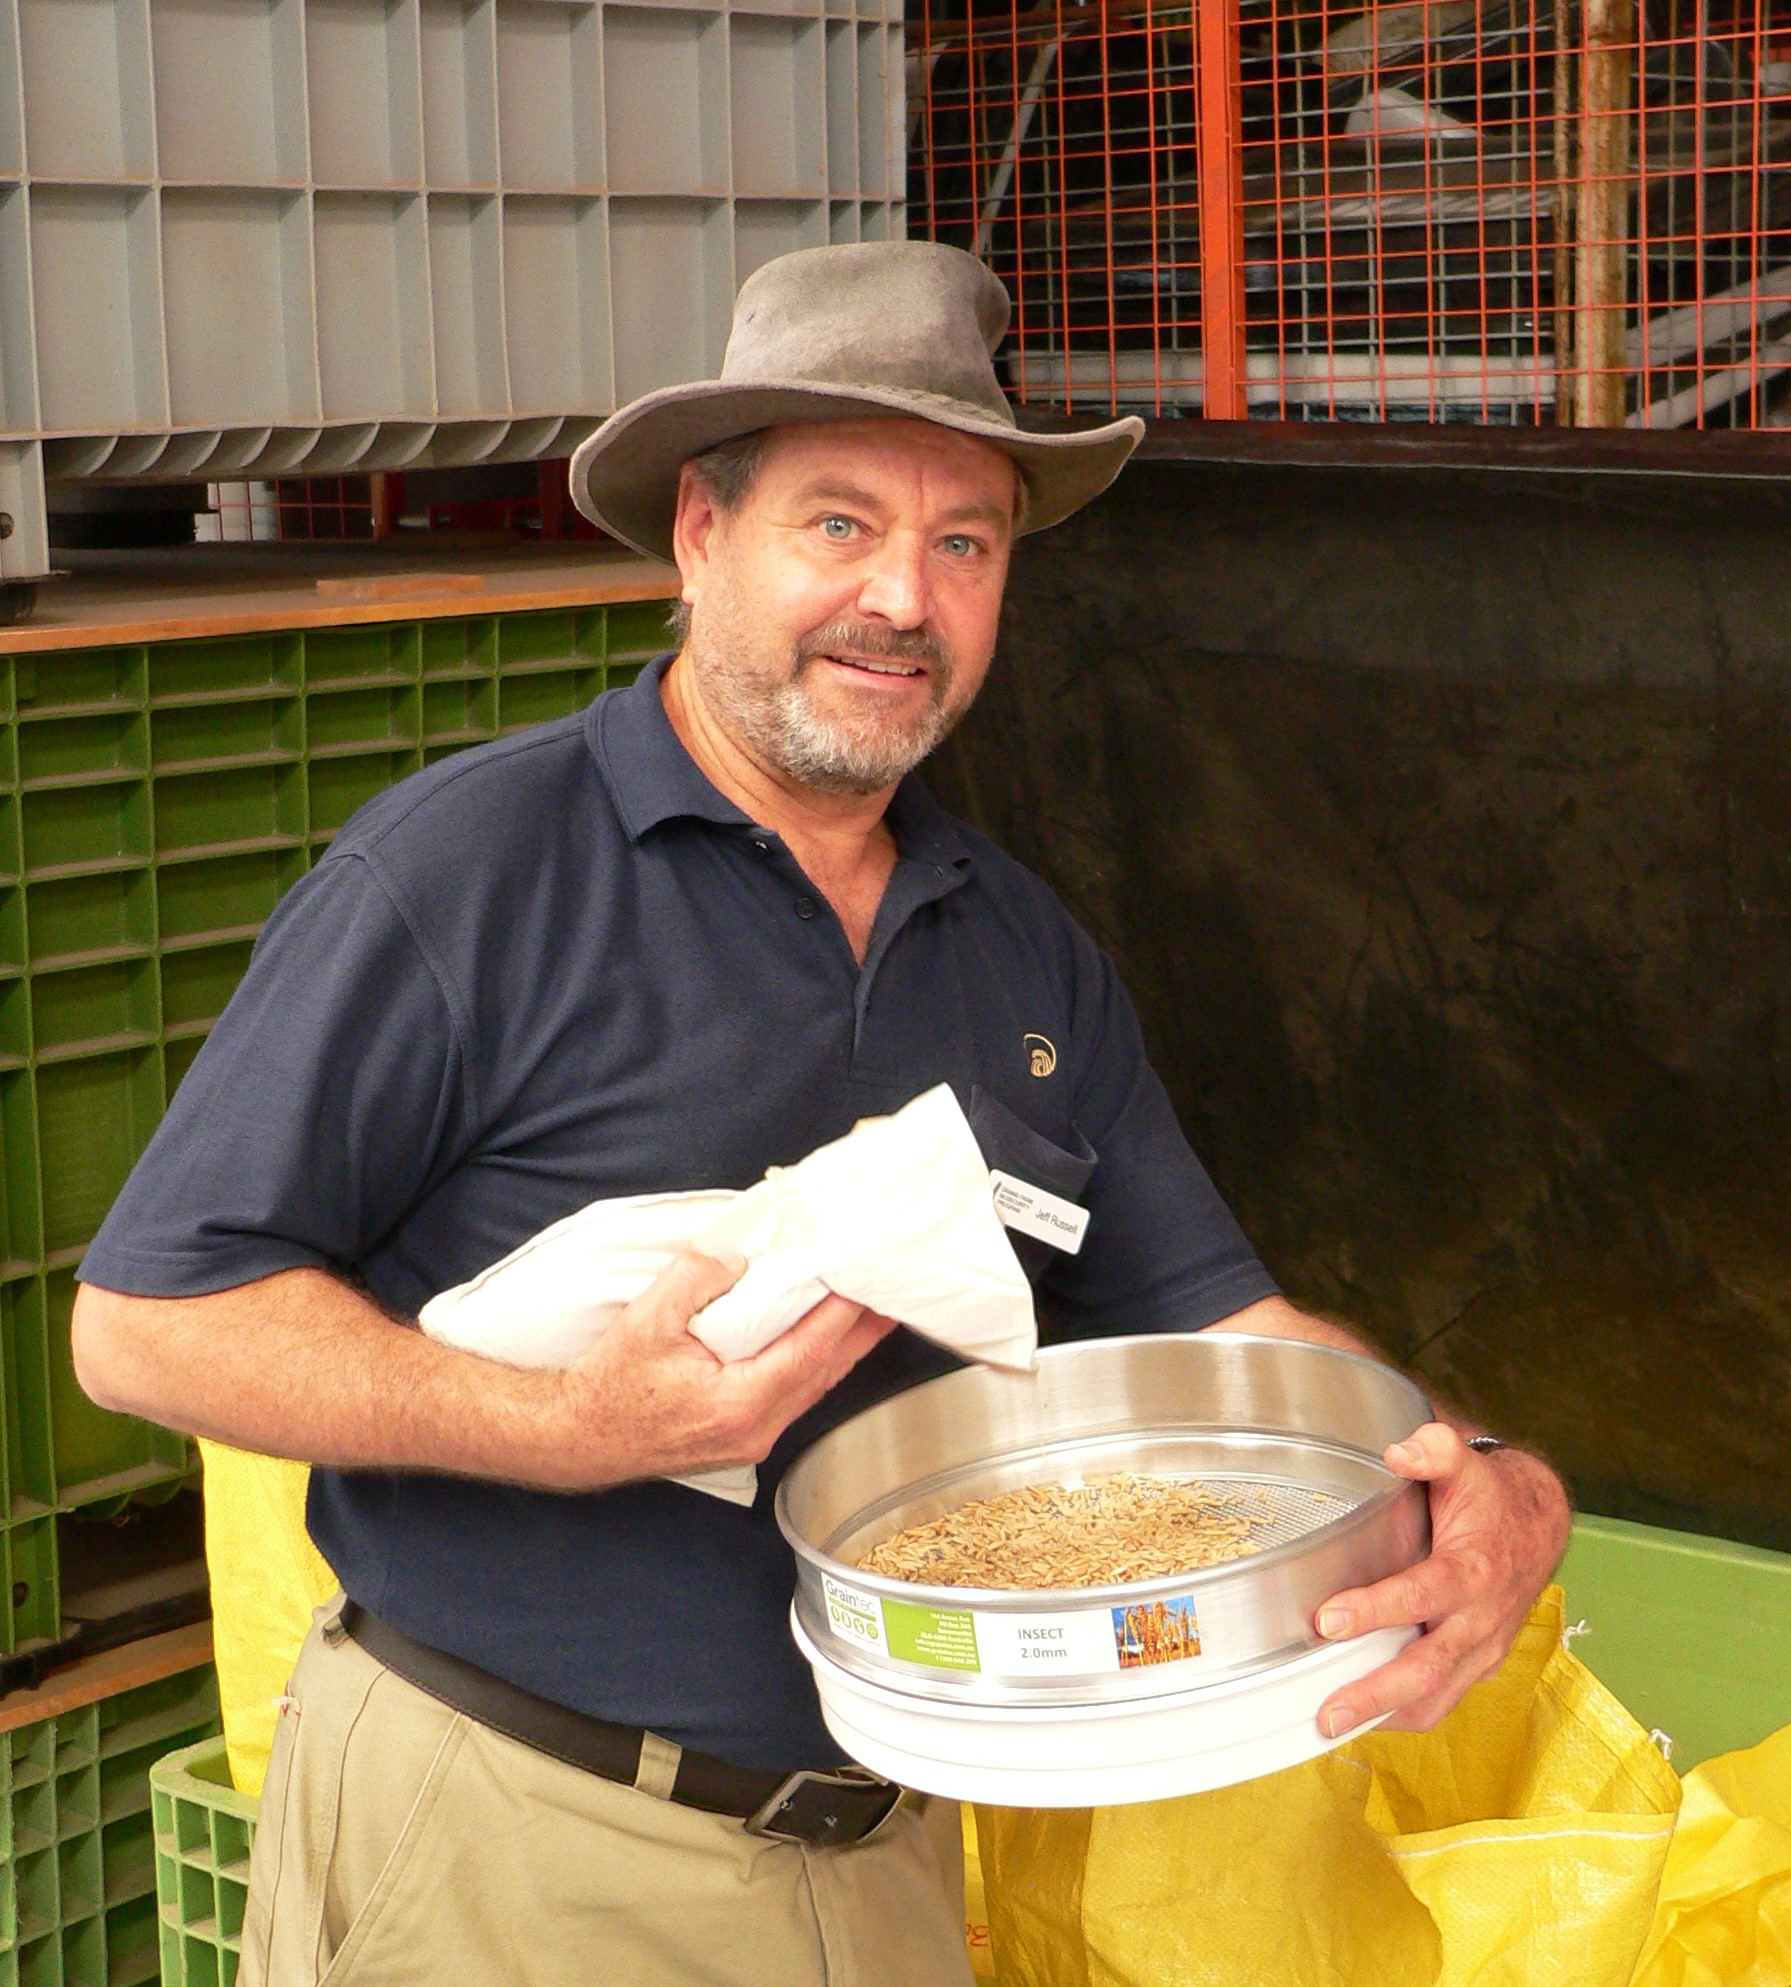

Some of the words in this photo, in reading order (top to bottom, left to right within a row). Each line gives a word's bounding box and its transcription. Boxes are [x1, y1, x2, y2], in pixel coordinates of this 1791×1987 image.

[1035, 1208, 1051, 1223] Jeff
[1050, 1214, 1079, 1235] Russell
[826, 1579, 876, 1614] Graintec
[1018, 1628, 1064, 1640] INSECT
[1020, 1647, 1067, 1658] 2.0mm
